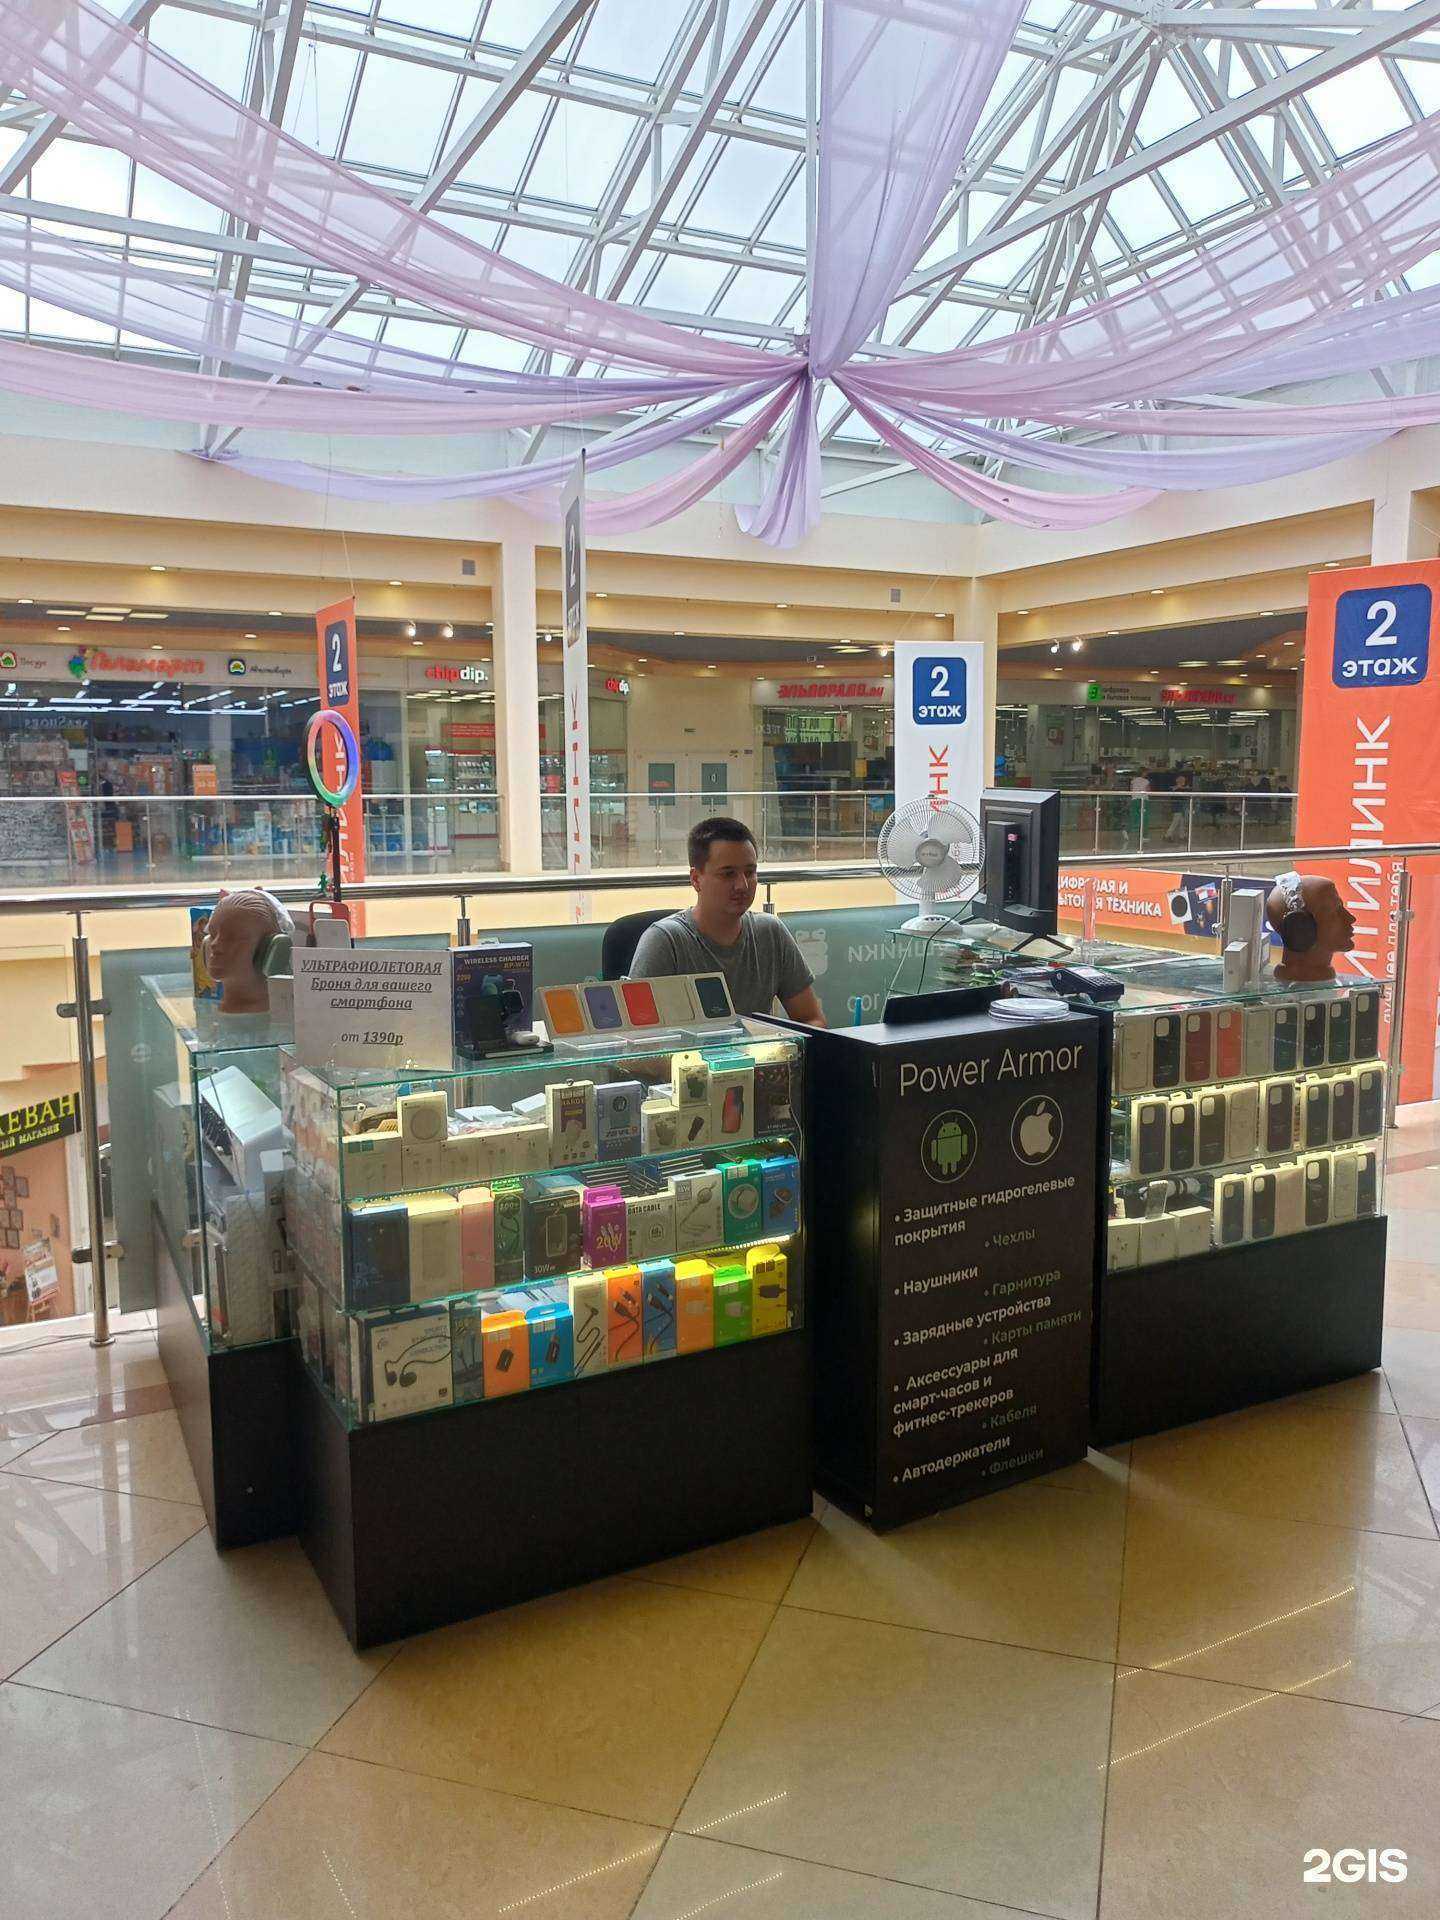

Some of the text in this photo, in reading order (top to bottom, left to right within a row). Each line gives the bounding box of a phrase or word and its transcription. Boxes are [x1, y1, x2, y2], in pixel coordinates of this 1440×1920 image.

[1365, 600, 1398, 646] 2
[331, 633, 342, 672] 2
[1341, 656, 1418, 678] этаж
[930, 665, 950, 698] 2
[918, 705, 962, 718] этаж
[1106, 896, 1162, 917] ТЕХНИКА
[301, 959, 442, 975] УЛЬТРАФИОЛЕТОВАЯ
[311, 977, 432, 993] Броня для вашего
[330, 996, 413, 1010] смартфона
[341, 1031, 404, 1046] от 1390р
[899, 1044, 1083, 1097] Power Armor
[0, 1093, 76, 1136] ЕВАН
[903, 1176, 1076, 1223] Защитные гидрогелевые
[894, 1219, 967, 1246] покрытия
[992, 1228, 1037, 1248] Чехлы
[902, 1265, 979, 1296] Наушники
[992, 1269, 1062, 1297] Гарнитура
[902, 1295, 1051, 1346] Зарядные устройства
[991, 1309, 1082, 1345] Карты памяти
[905, 1347, 1019, 1392] Аксессуары для
[893, 1375, 993, 1415] смарт-часов и
[892, 1388, 1014, 1438] фитнес-трекеров
[902, 1436, 1011, 1483] Автодержатели
[989, 1449, 1045, 1475] Флешки
